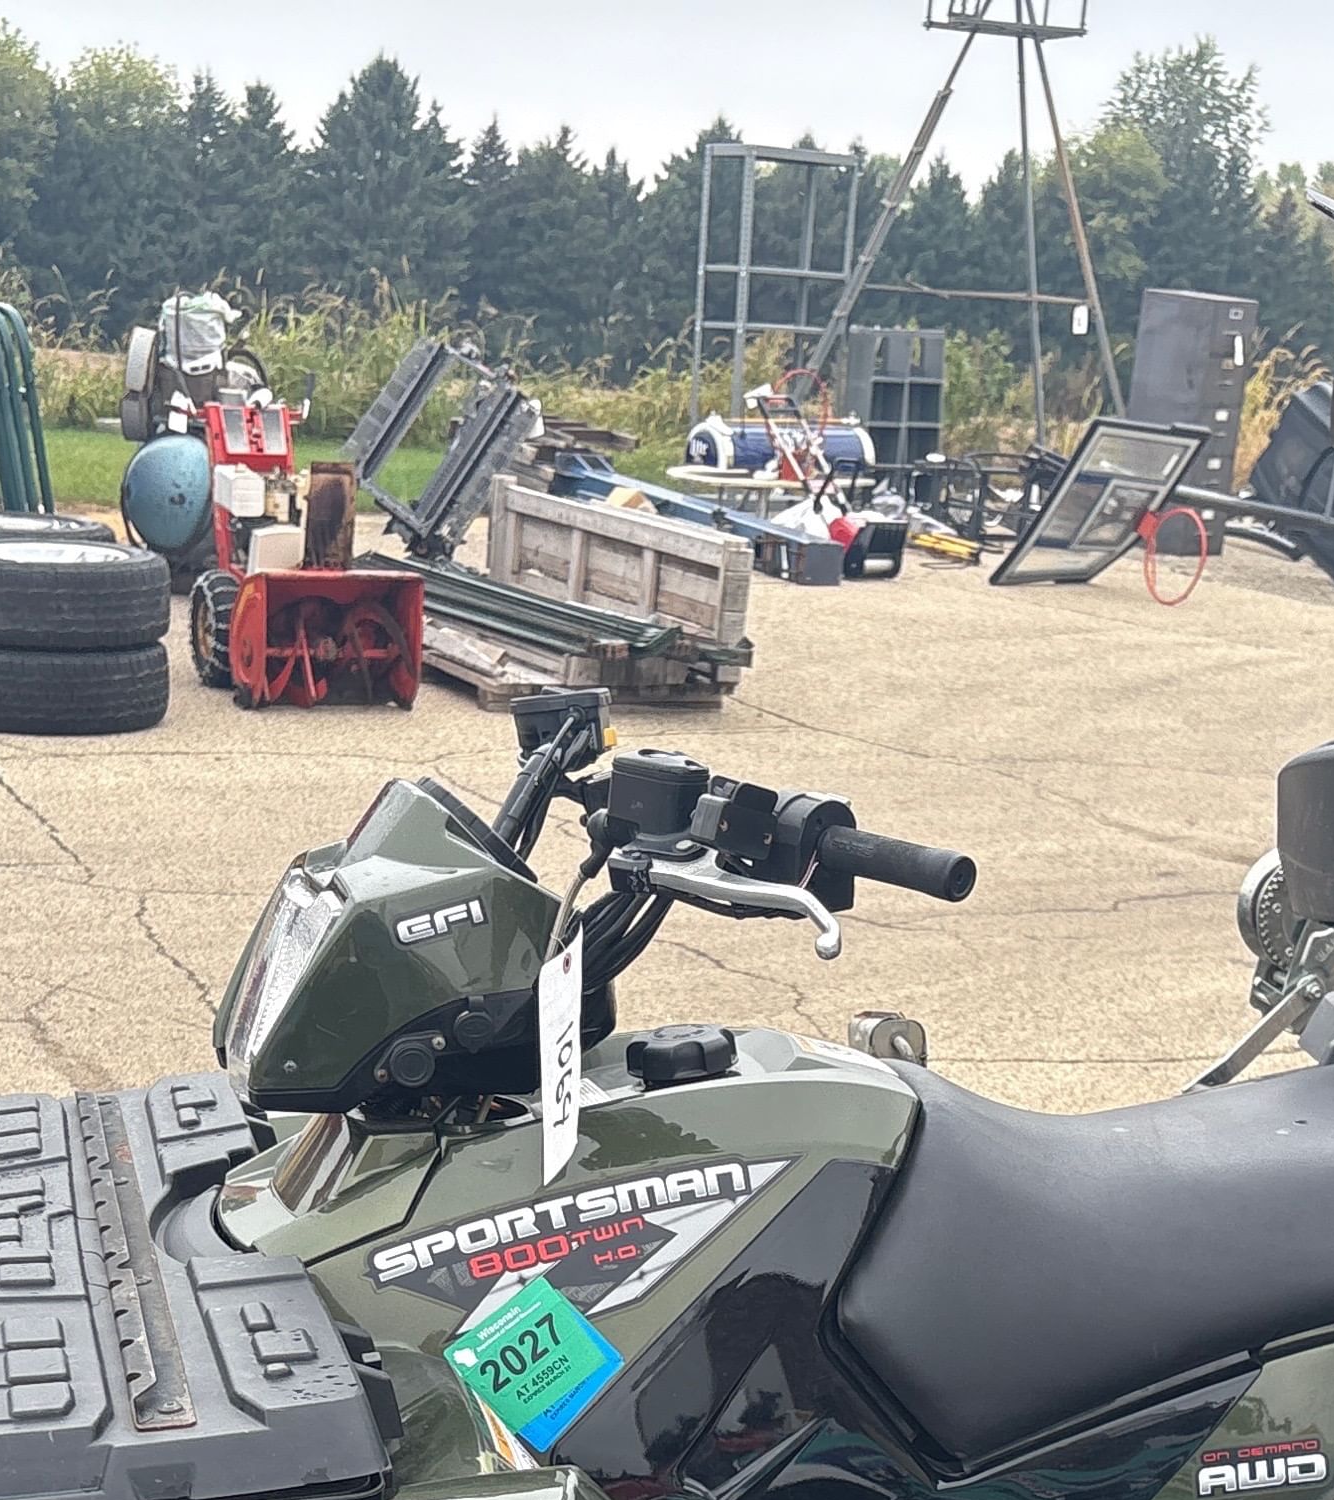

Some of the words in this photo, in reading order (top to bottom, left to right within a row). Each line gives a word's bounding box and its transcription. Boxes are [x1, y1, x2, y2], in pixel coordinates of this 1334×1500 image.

[396, 899, 484, 943] EFI
[373, 1162, 746, 1283] SPORTSMAN
[578, 1216, 645, 1246] TWIN
[476, 1305, 522, 1341] Wisconsin
[479, 1312, 561, 1394] 2027
[516, 1382, 533, 1401] AT
[531, 1354, 570, 1388] 4559CN
[1203, 1451, 1230, 1463] ON
[1238, 1440, 1318, 1458] DEMAND
[1198, 1453, 1327, 1496] AWD
